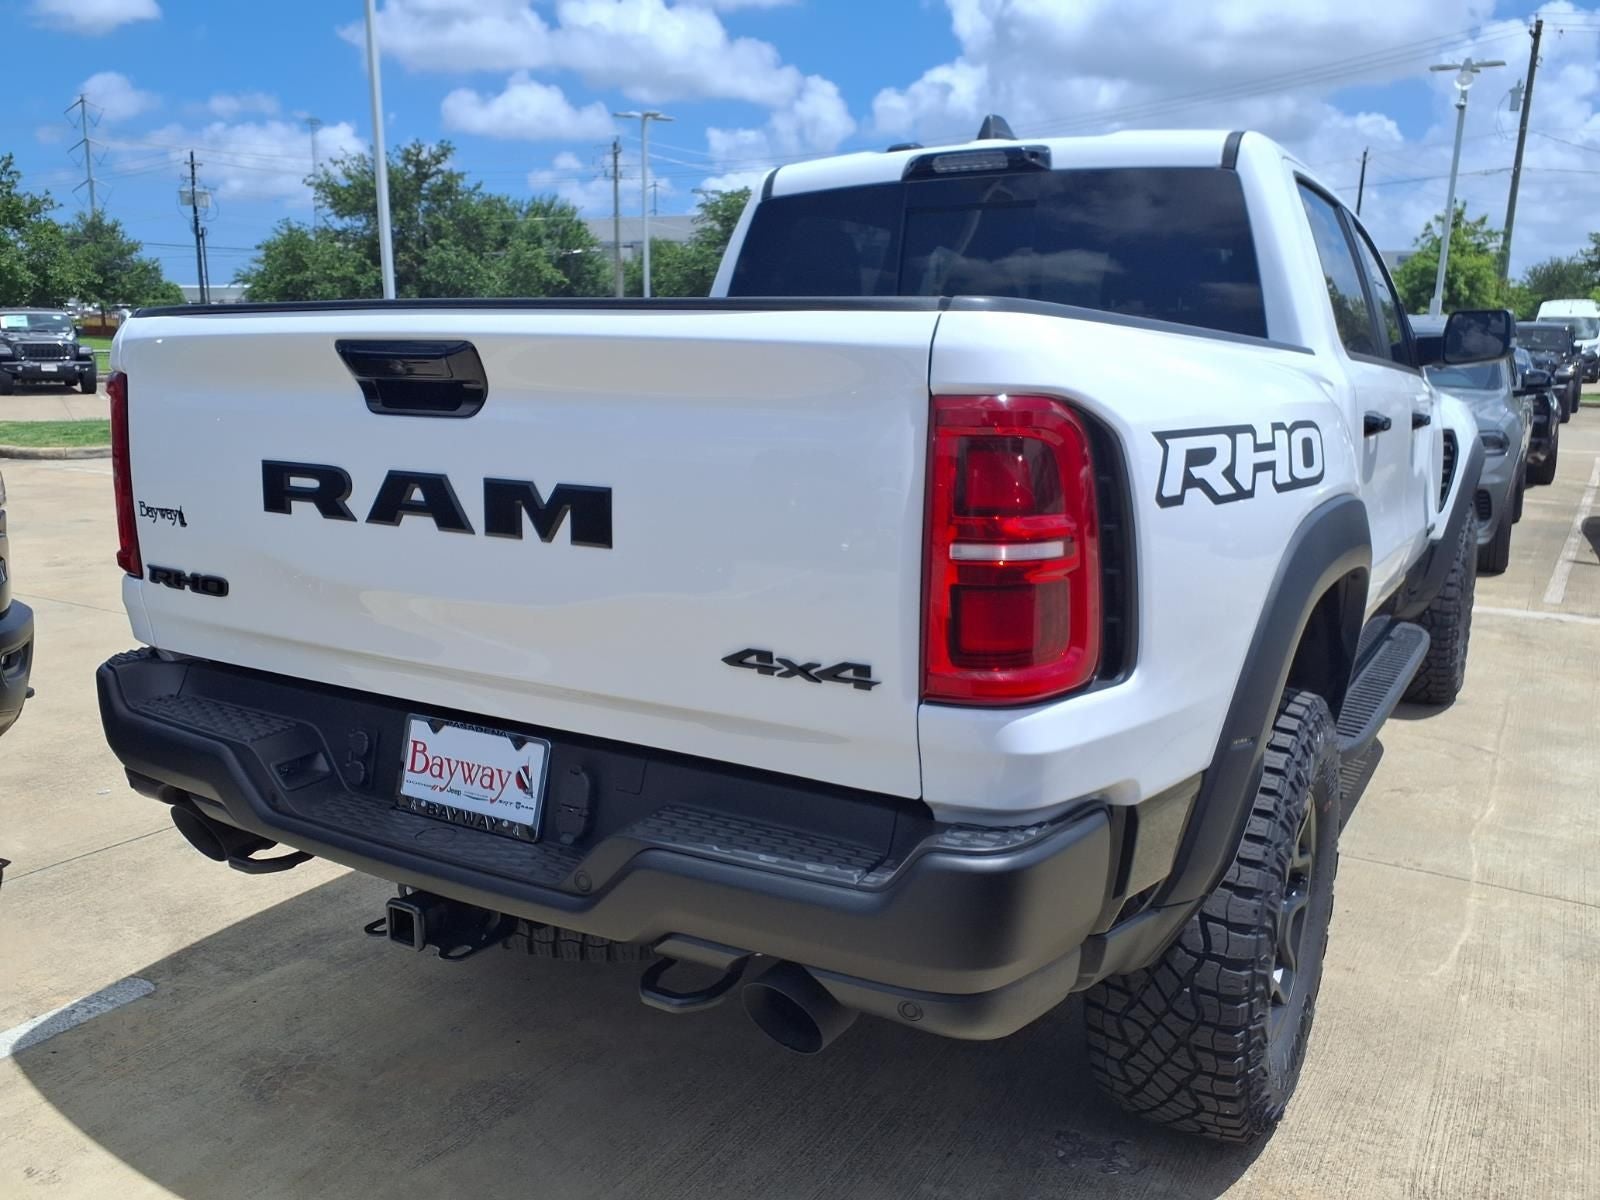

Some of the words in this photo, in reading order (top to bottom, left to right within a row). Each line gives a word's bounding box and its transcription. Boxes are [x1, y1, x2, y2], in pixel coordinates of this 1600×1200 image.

[1151, 420, 1325, 509] RHO
[138, 500, 181, 526] Bayway
[261, 459, 613, 549] RAM
[146, 564, 229, 597] RHO
[447, 720, 508, 738] PASADENA
[407, 739, 513, 804] Bayway
[426, 803, 498, 831] BAYWAY
